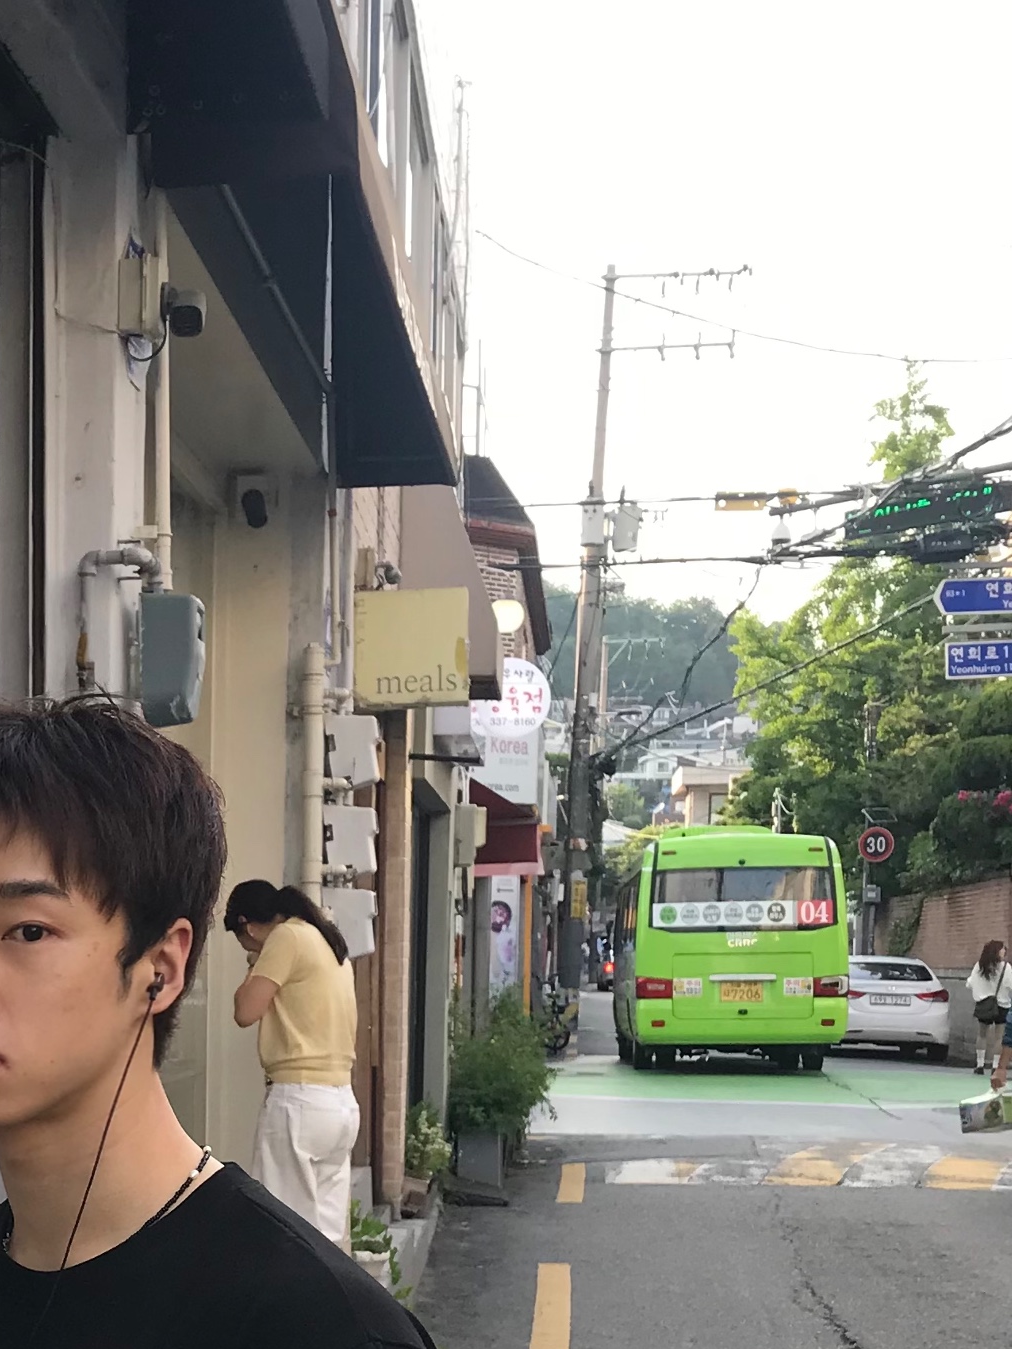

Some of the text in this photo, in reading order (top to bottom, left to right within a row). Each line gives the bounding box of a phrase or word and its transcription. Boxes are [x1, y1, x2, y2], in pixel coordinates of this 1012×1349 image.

[503, 669, 535, 683] 우사랑
[951, 663, 1001, 673] Yeonhui-ro
[376, 664, 457, 694] meals
[490, 738, 529, 755] Korea
[866, 836, 886, 853] 30
[800, 901, 829, 924] 04
